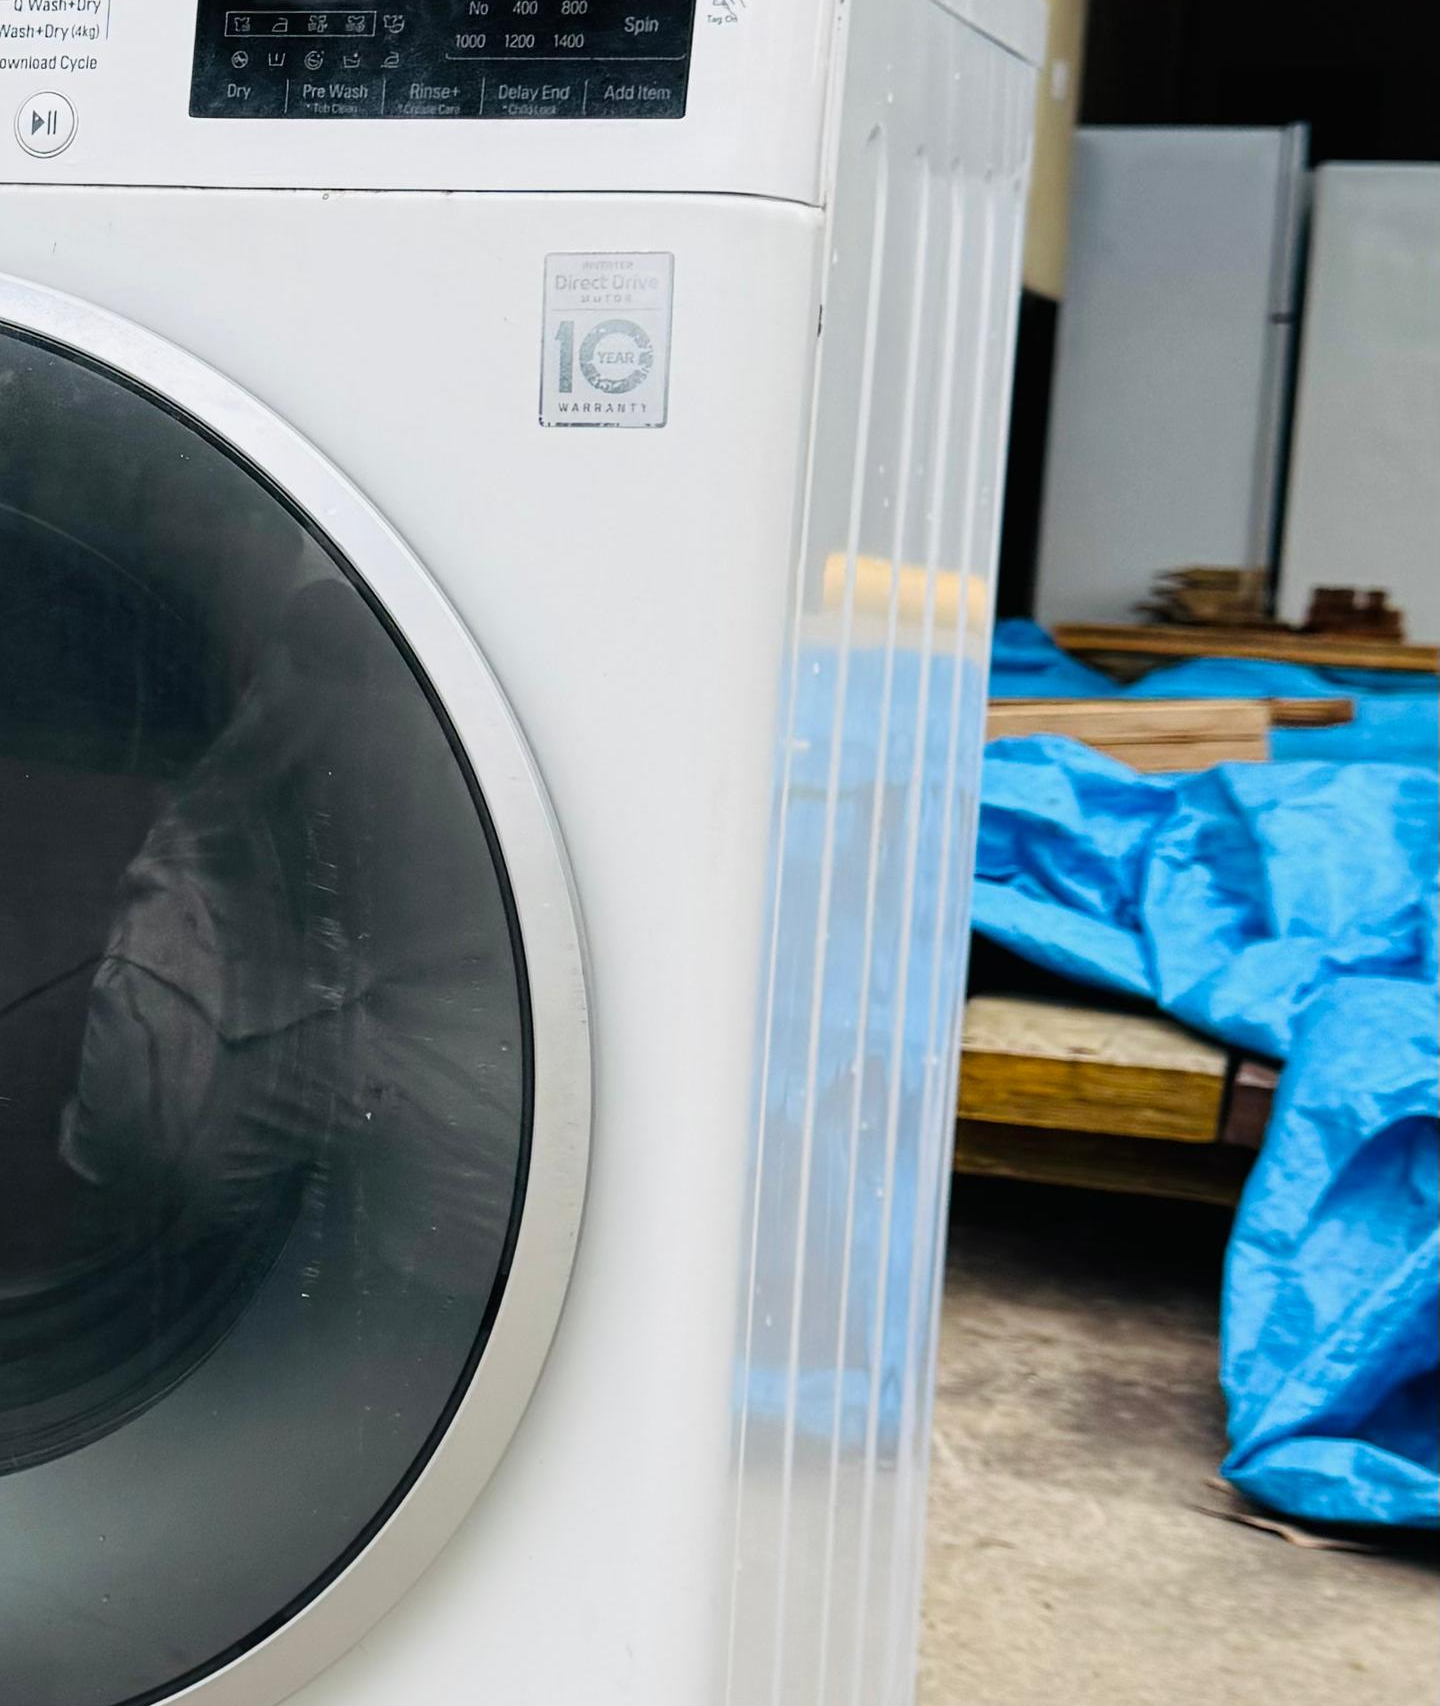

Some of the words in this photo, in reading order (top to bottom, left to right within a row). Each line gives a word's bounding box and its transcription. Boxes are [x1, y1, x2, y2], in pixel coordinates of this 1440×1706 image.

[469, 1, 489, 15] No
[513, 0, 538, 15] 400
[561, 0, 588, 15] 800
[71, 25, 100, 41] (4kg)
[624, 17, 659, 35] Spin
[455, 34, 486, 48] 1000
[505, 34, 535, 48] 1200
[554, 34, 585, 48] 1400
[60, 55, 97, 73] Cycle
[227, 84, 251, 100] Dry
[303, 84, 326, 98] Pre
[329, 84, 368, 98] Wash
[410, 84, 460, 99] Rinse+
[498, 85, 537, 101] Delay
[542, 85, 570, 100] End
[604, 85, 635, 100] Add
[638, 85, 671, 100] Item
[555, 275, 608, 291] Direct
[612, 275, 659, 291] Drive
[554, 319, 653, 394] 10
[597, 351, 634, 365] YEAR
[558, 403, 648, 413] WARRANTY
